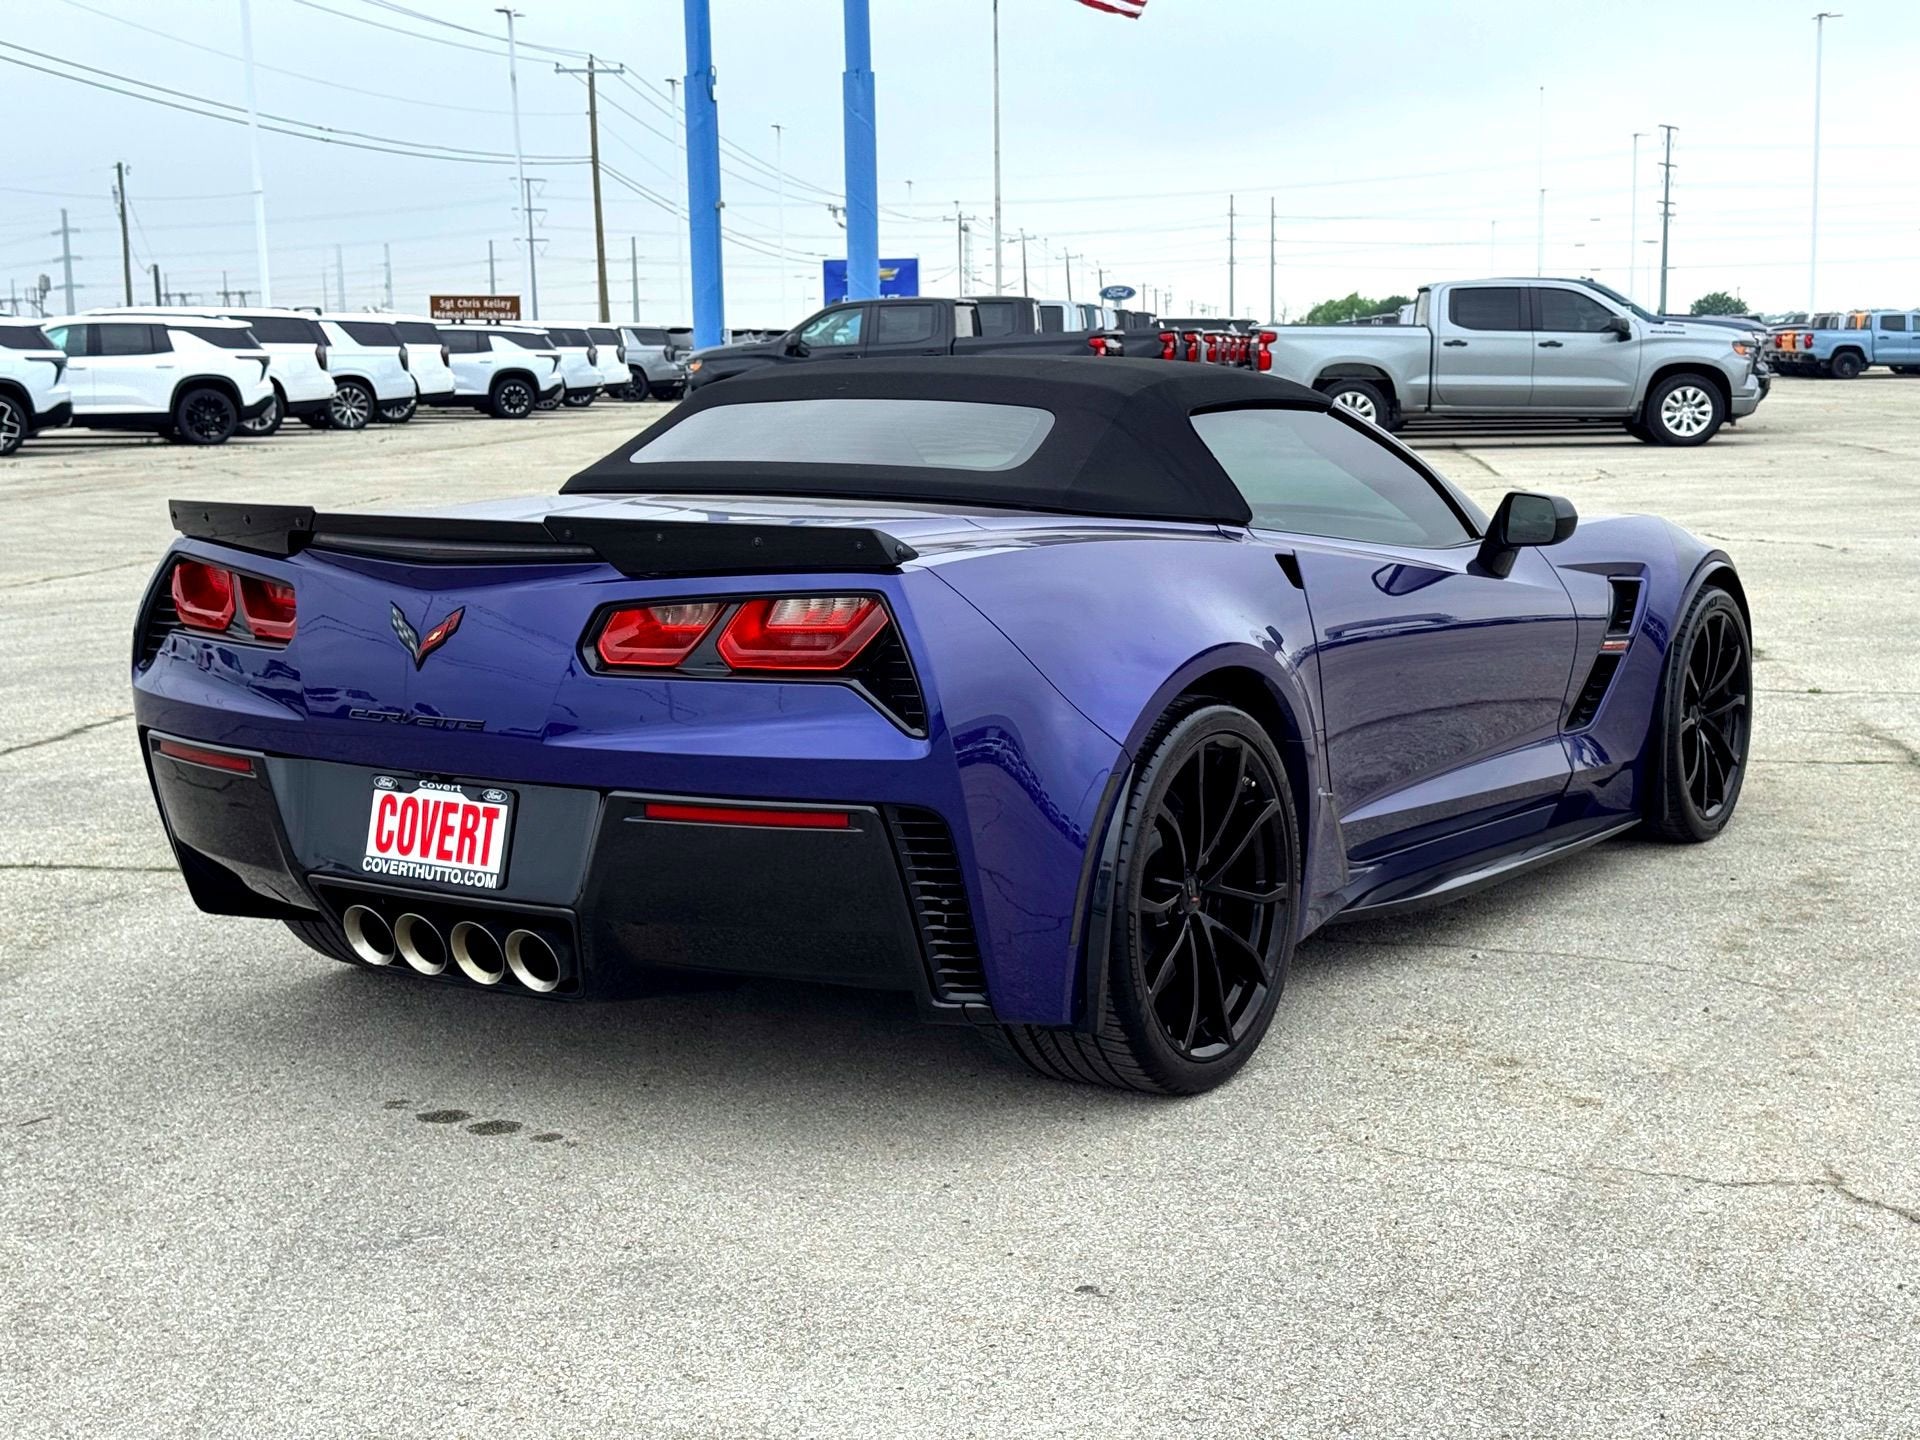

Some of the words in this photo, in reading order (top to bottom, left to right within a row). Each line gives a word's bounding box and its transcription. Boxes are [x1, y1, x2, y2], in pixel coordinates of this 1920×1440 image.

[439, 299, 454, 310] Sgt
[457, 298, 480, 308] Chris
[483, 298, 511, 310] Kelley
[433, 310, 475, 319] Memorial
[478, 310, 517, 319] Highway
[349, 708, 486, 732] CORVETTE
[418, 780, 462, 792] Covert
[375, 794, 500, 867] COVERT
[362, 857, 498, 889] COVERTHUTTO.COM
